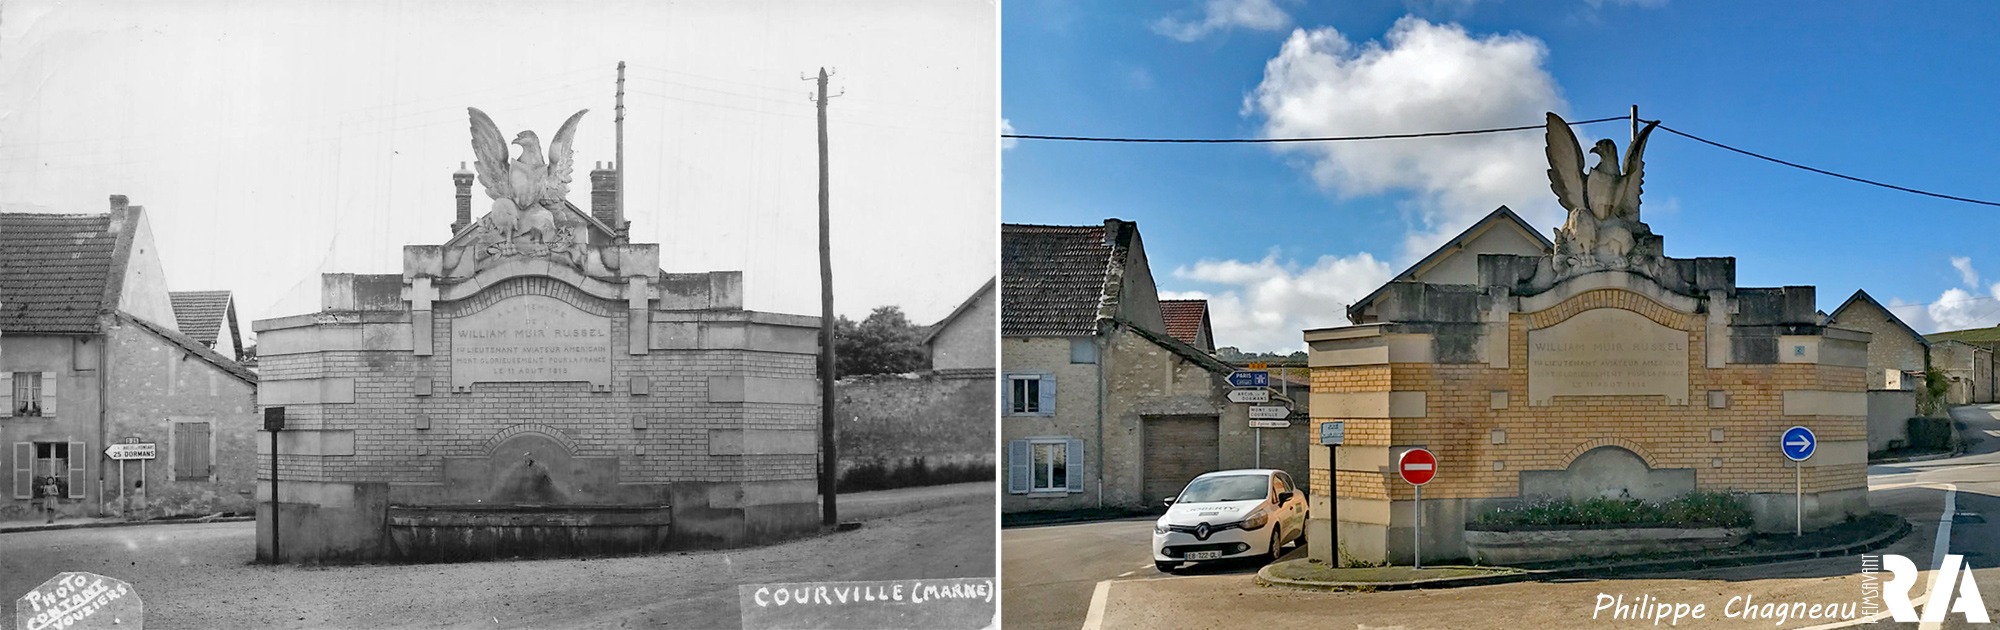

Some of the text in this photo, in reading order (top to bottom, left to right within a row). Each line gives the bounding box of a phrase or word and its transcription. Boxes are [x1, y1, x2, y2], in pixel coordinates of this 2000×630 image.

[457, 329, 605, 339] WILLIAM MUIR RUSSEL
[467, 346, 518, 354] LIEUTENANT
[522, 346, 561, 354] AVIATEUR
[564, 346, 606, 354] AMERICAIN
[1534, 342, 1683, 352] WILLIAM MUIR RUSSEL
